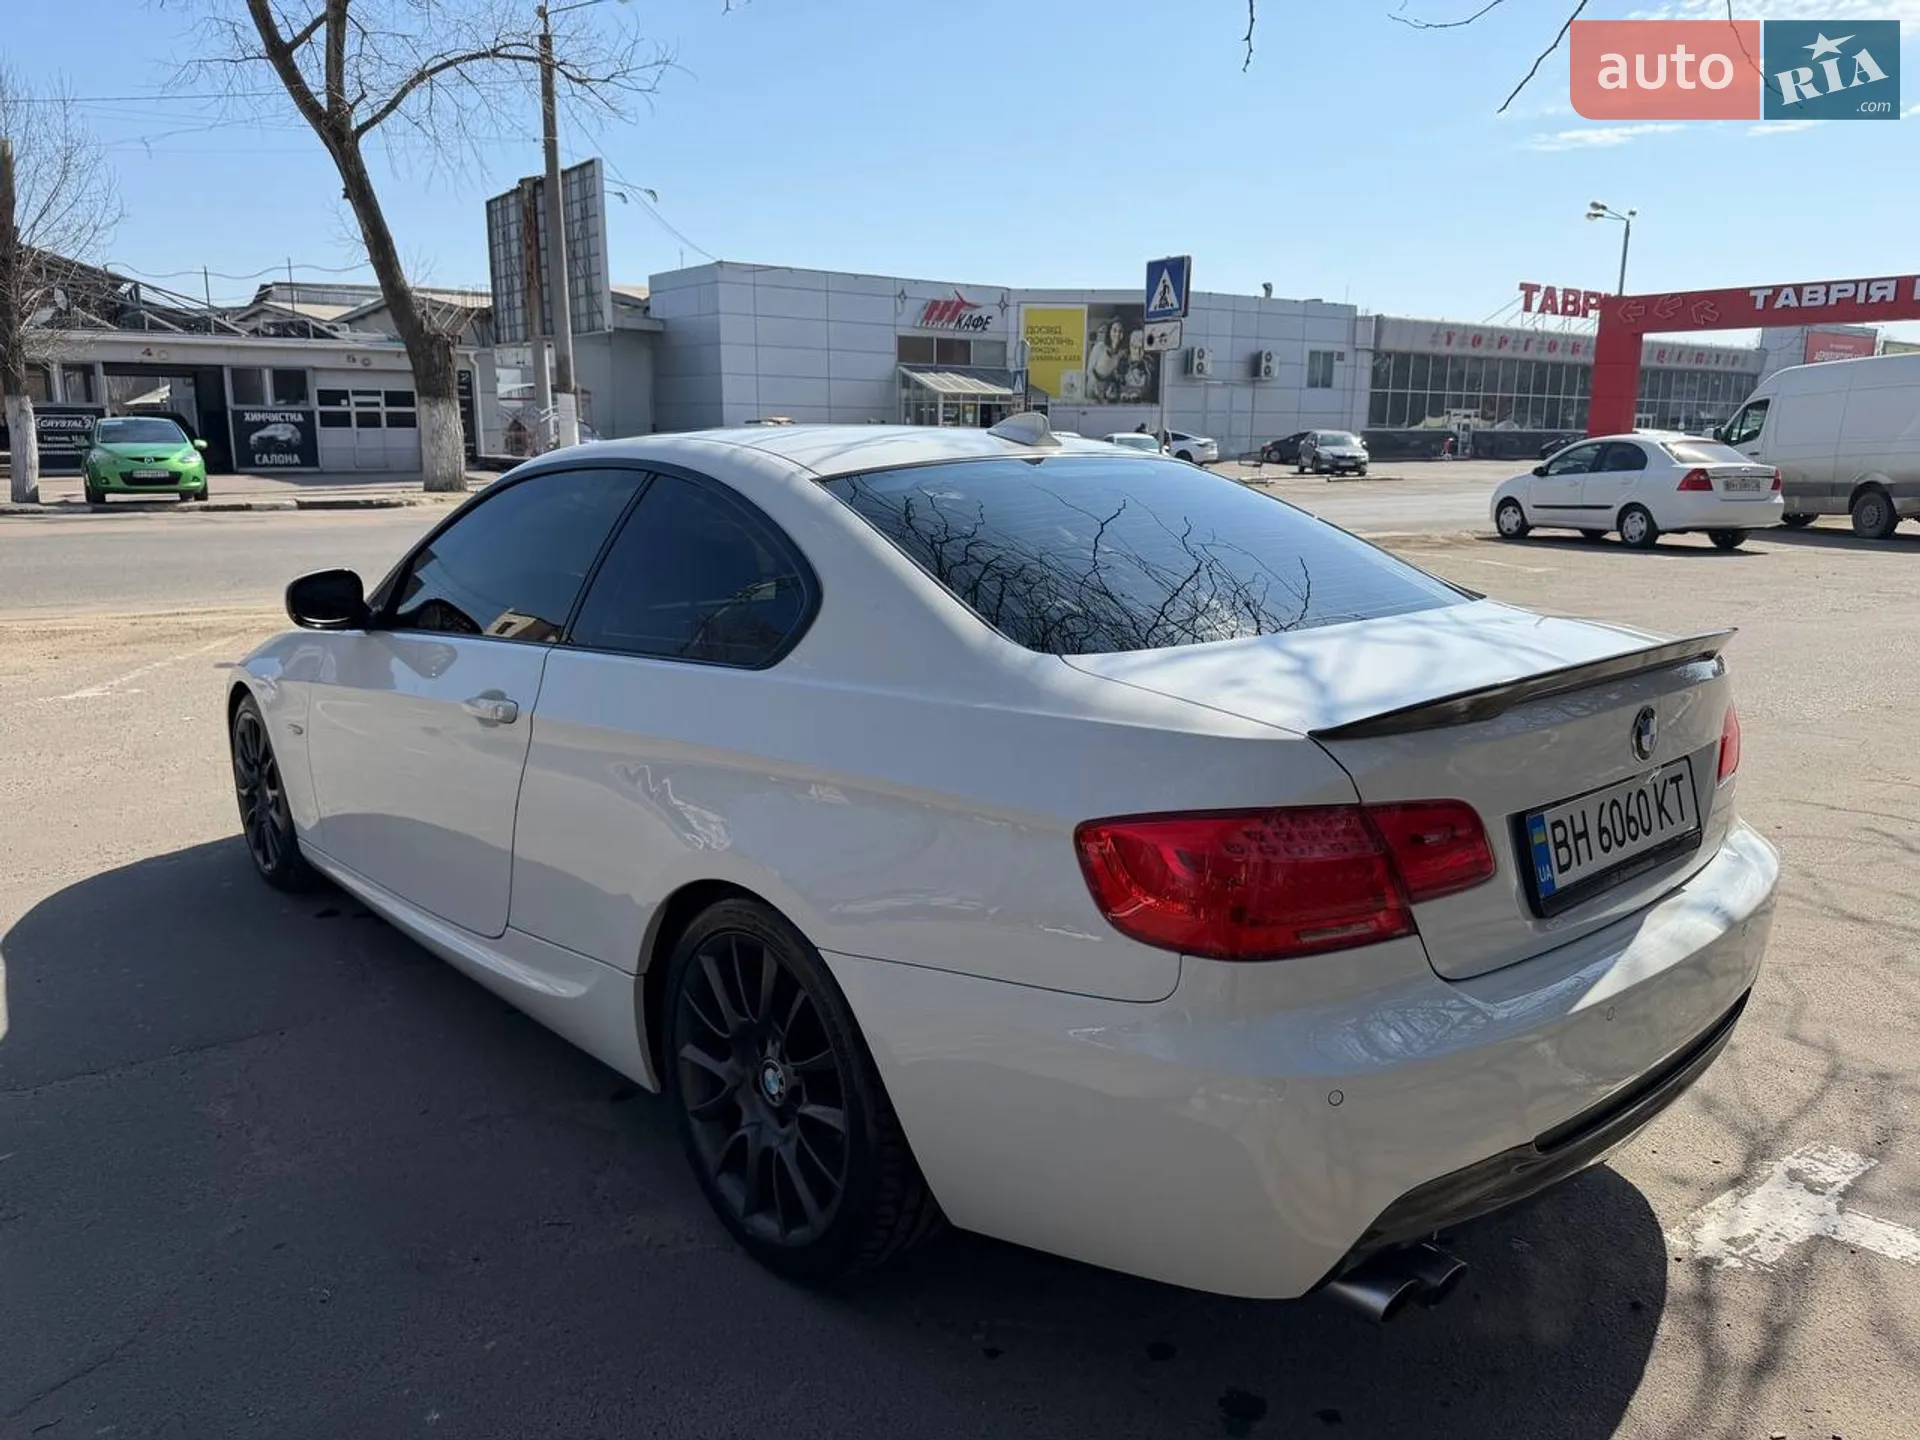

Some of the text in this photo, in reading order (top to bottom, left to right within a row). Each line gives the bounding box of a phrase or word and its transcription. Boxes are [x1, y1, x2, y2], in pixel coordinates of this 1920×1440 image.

[1519, 282, 1606, 318] ТАВР
[1749, 279, 1897, 311] ТАВРІЯ
[954, 312, 993, 331] КАФЕ
[1445, 331, 1582, 356] ТОРГОВ
[243, 411, 305, 422] ХИМЧИСТКА
[254, 453, 301, 465] САЛОНА
[1551, 773, 1686, 875] BH 6060 KT
[1538, 864, 1553, 883] UA
